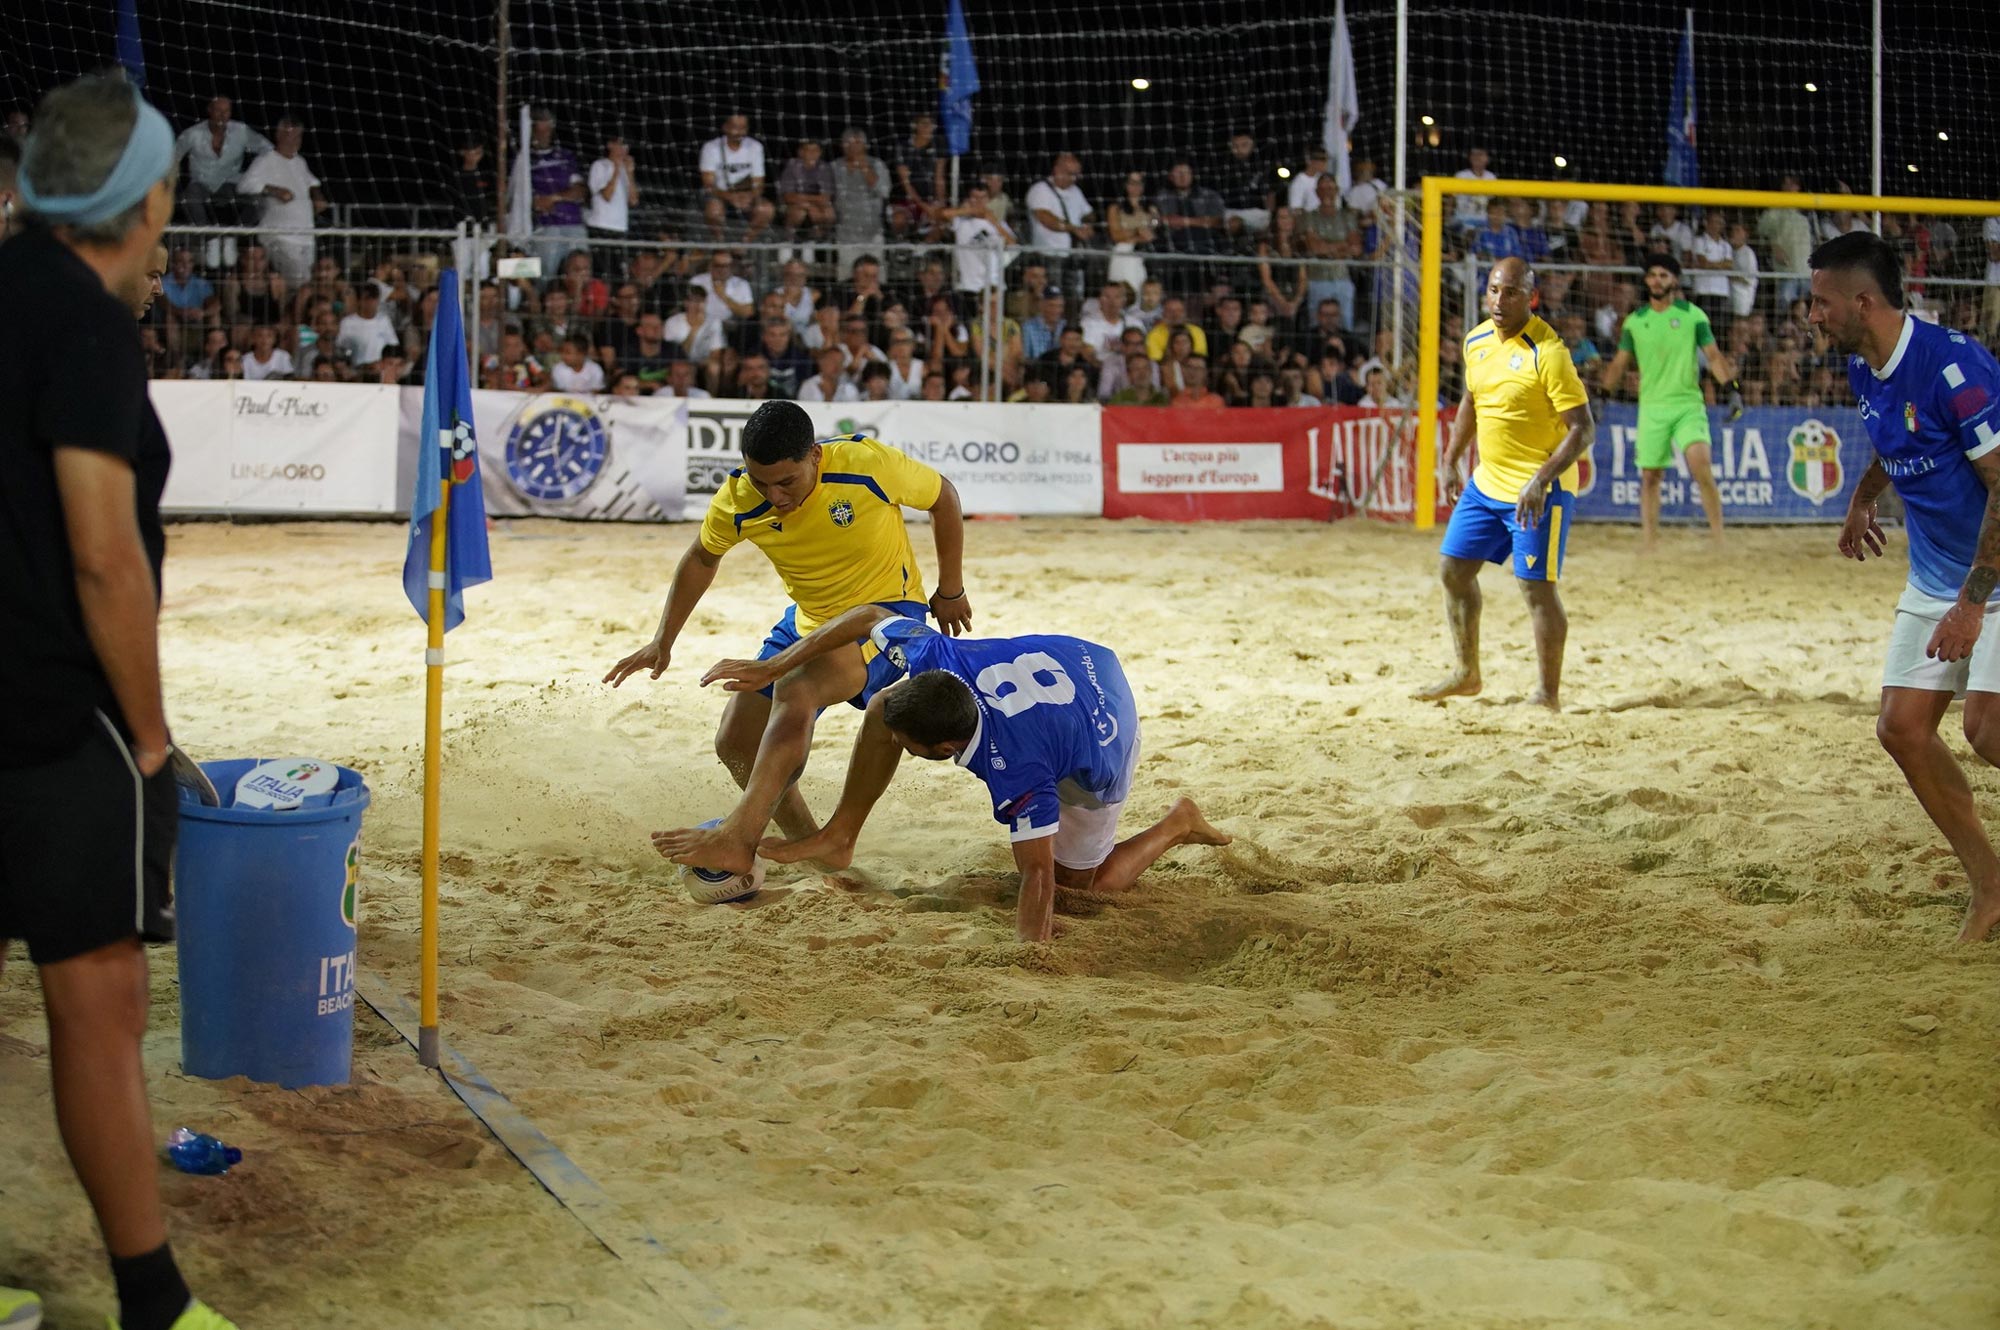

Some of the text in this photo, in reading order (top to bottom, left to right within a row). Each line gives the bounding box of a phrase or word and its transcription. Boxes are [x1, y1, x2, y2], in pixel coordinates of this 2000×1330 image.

[889, 441, 1020, 463] INEAORO
[1161, 448, 1240, 466] L'acqua più
[231, 463, 326, 480] LINEAORO
[686, 466, 728, 488] GIO
[1141, 467, 1259, 488] leggera d'Europa
[1612, 481, 1774, 505] BECH SCCER
[976, 652, 1076, 718] 8
[250, 774, 305, 798] ITALIA
[319, 952, 355, 997] ITA
[318, 991, 354, 1016] BEAC
